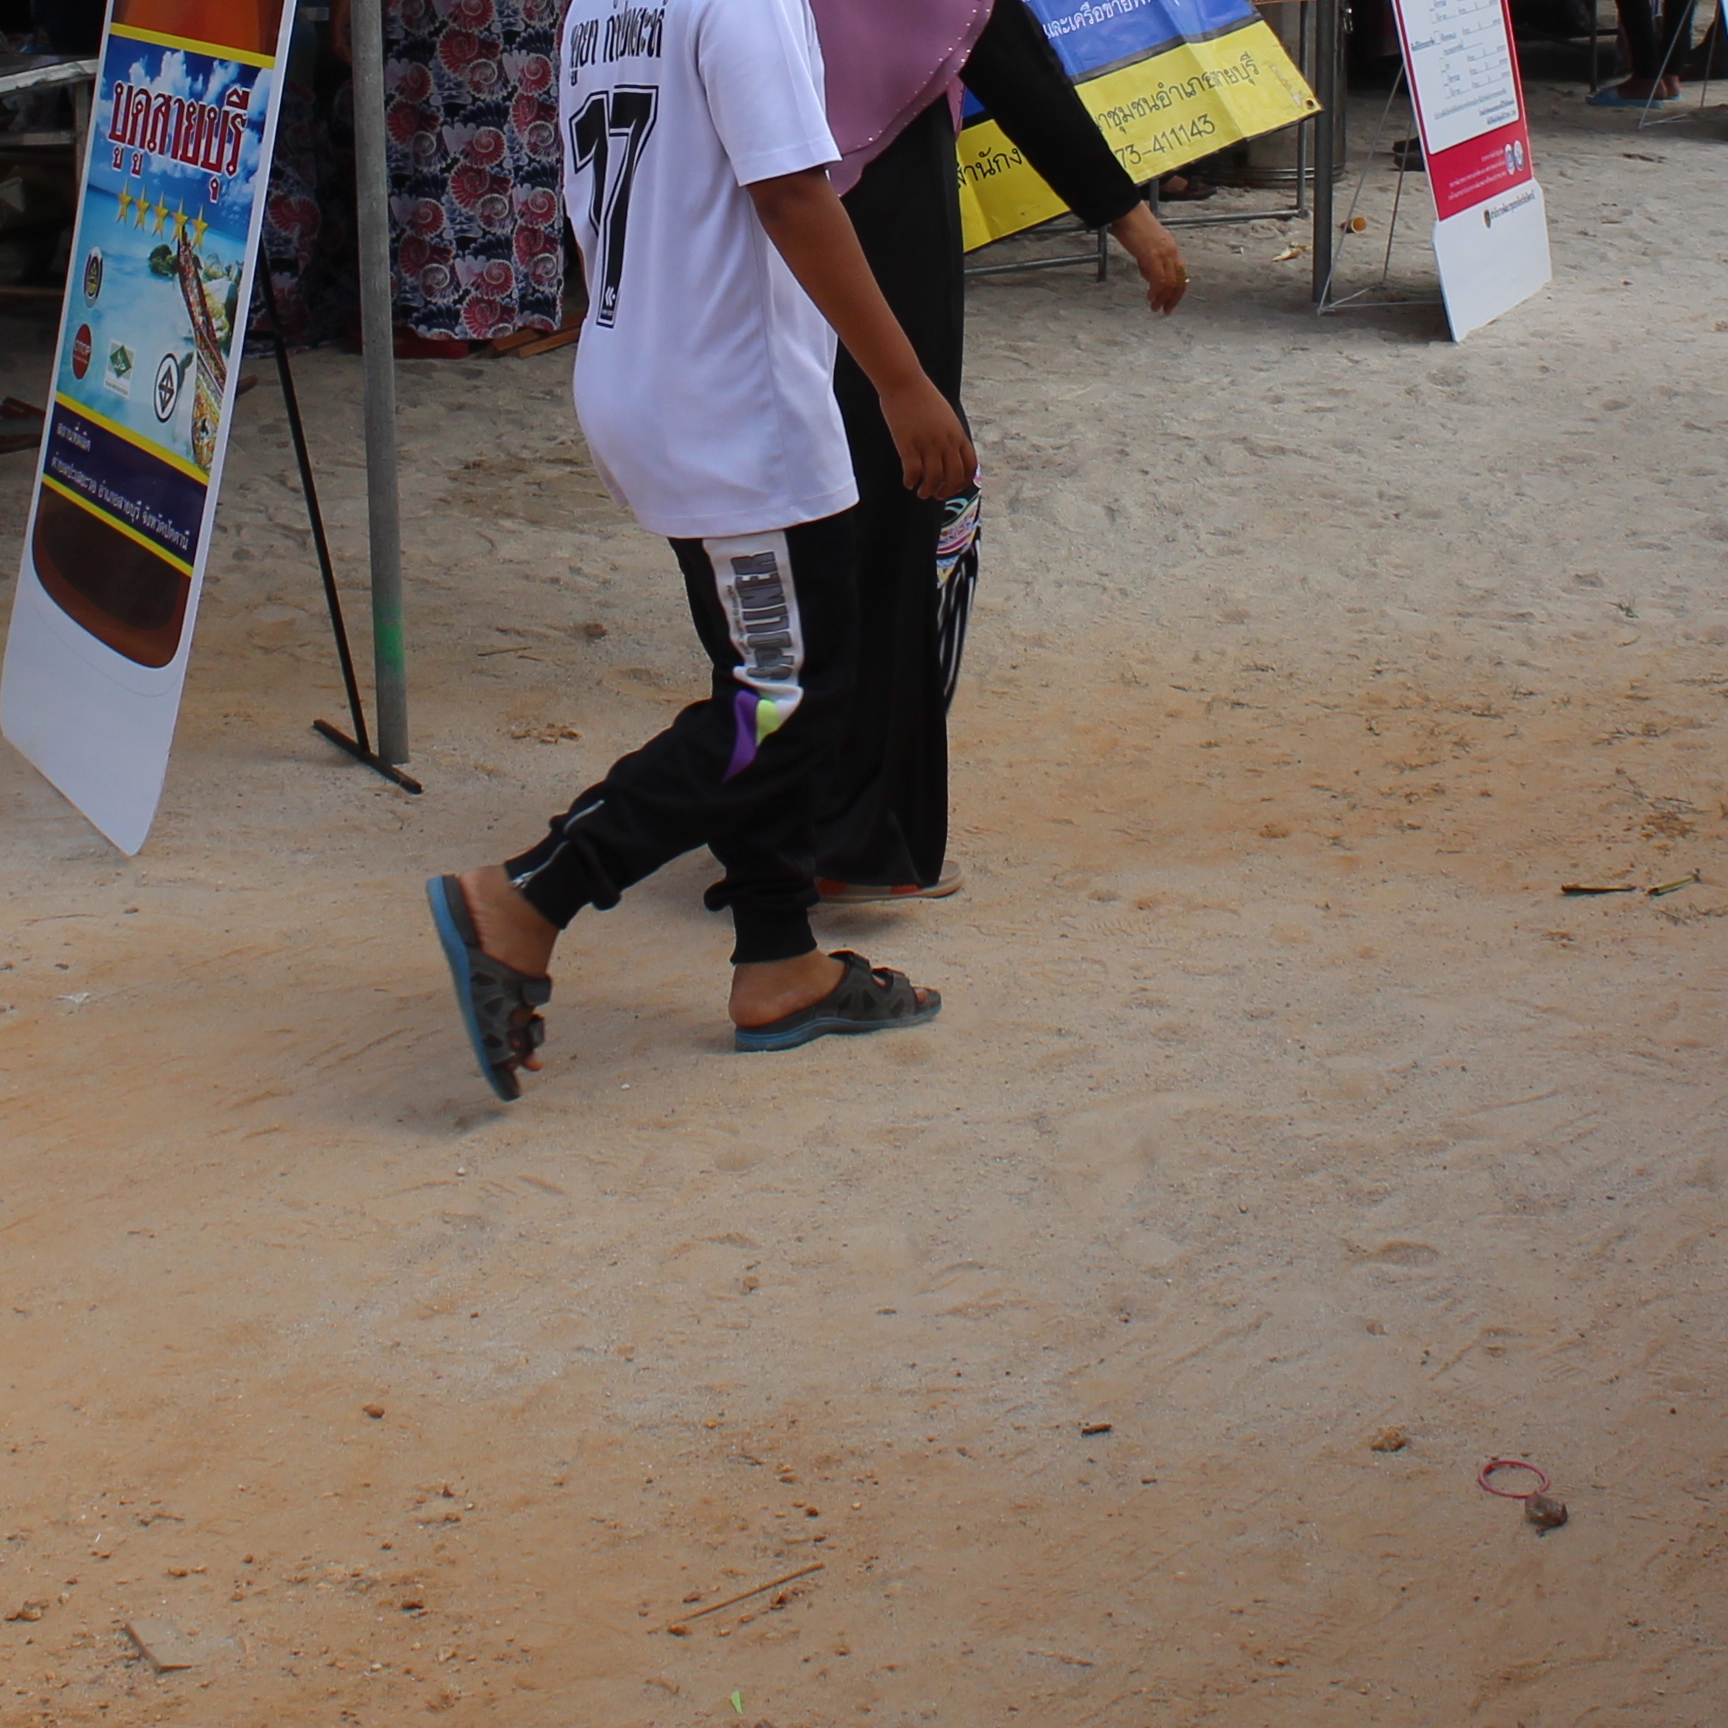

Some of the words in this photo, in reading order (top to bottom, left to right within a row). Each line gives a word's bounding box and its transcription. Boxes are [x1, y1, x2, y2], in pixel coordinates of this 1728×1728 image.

[107, 78, 252, 204] บูดูสายบุรี
[568, 83, 660, 330] 17
